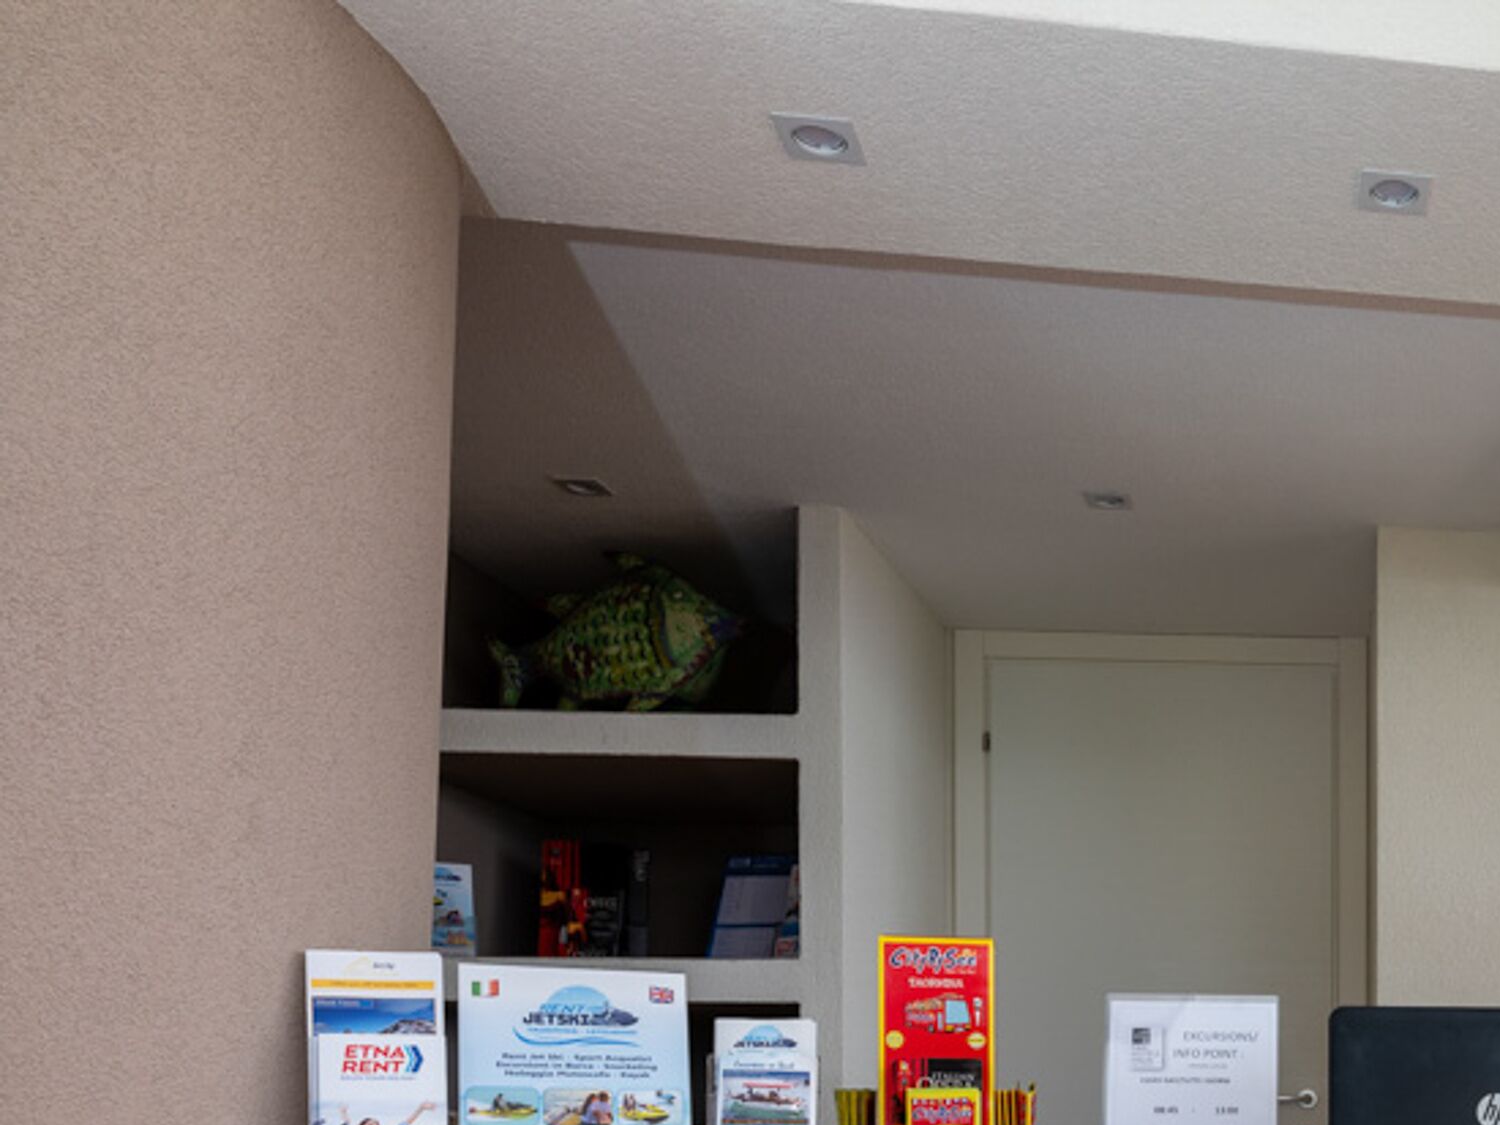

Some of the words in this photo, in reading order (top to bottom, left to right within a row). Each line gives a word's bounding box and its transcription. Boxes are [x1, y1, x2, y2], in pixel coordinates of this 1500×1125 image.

[523, 1011, 590, 1026] JETSKI
[345, 1043, 405, 1059] ETNA
[1172, 1048, 1201, 1059] INFO
[1203, 1048, 1238, 1059] POINT
[342, 1060, 405, 1073] RENT
